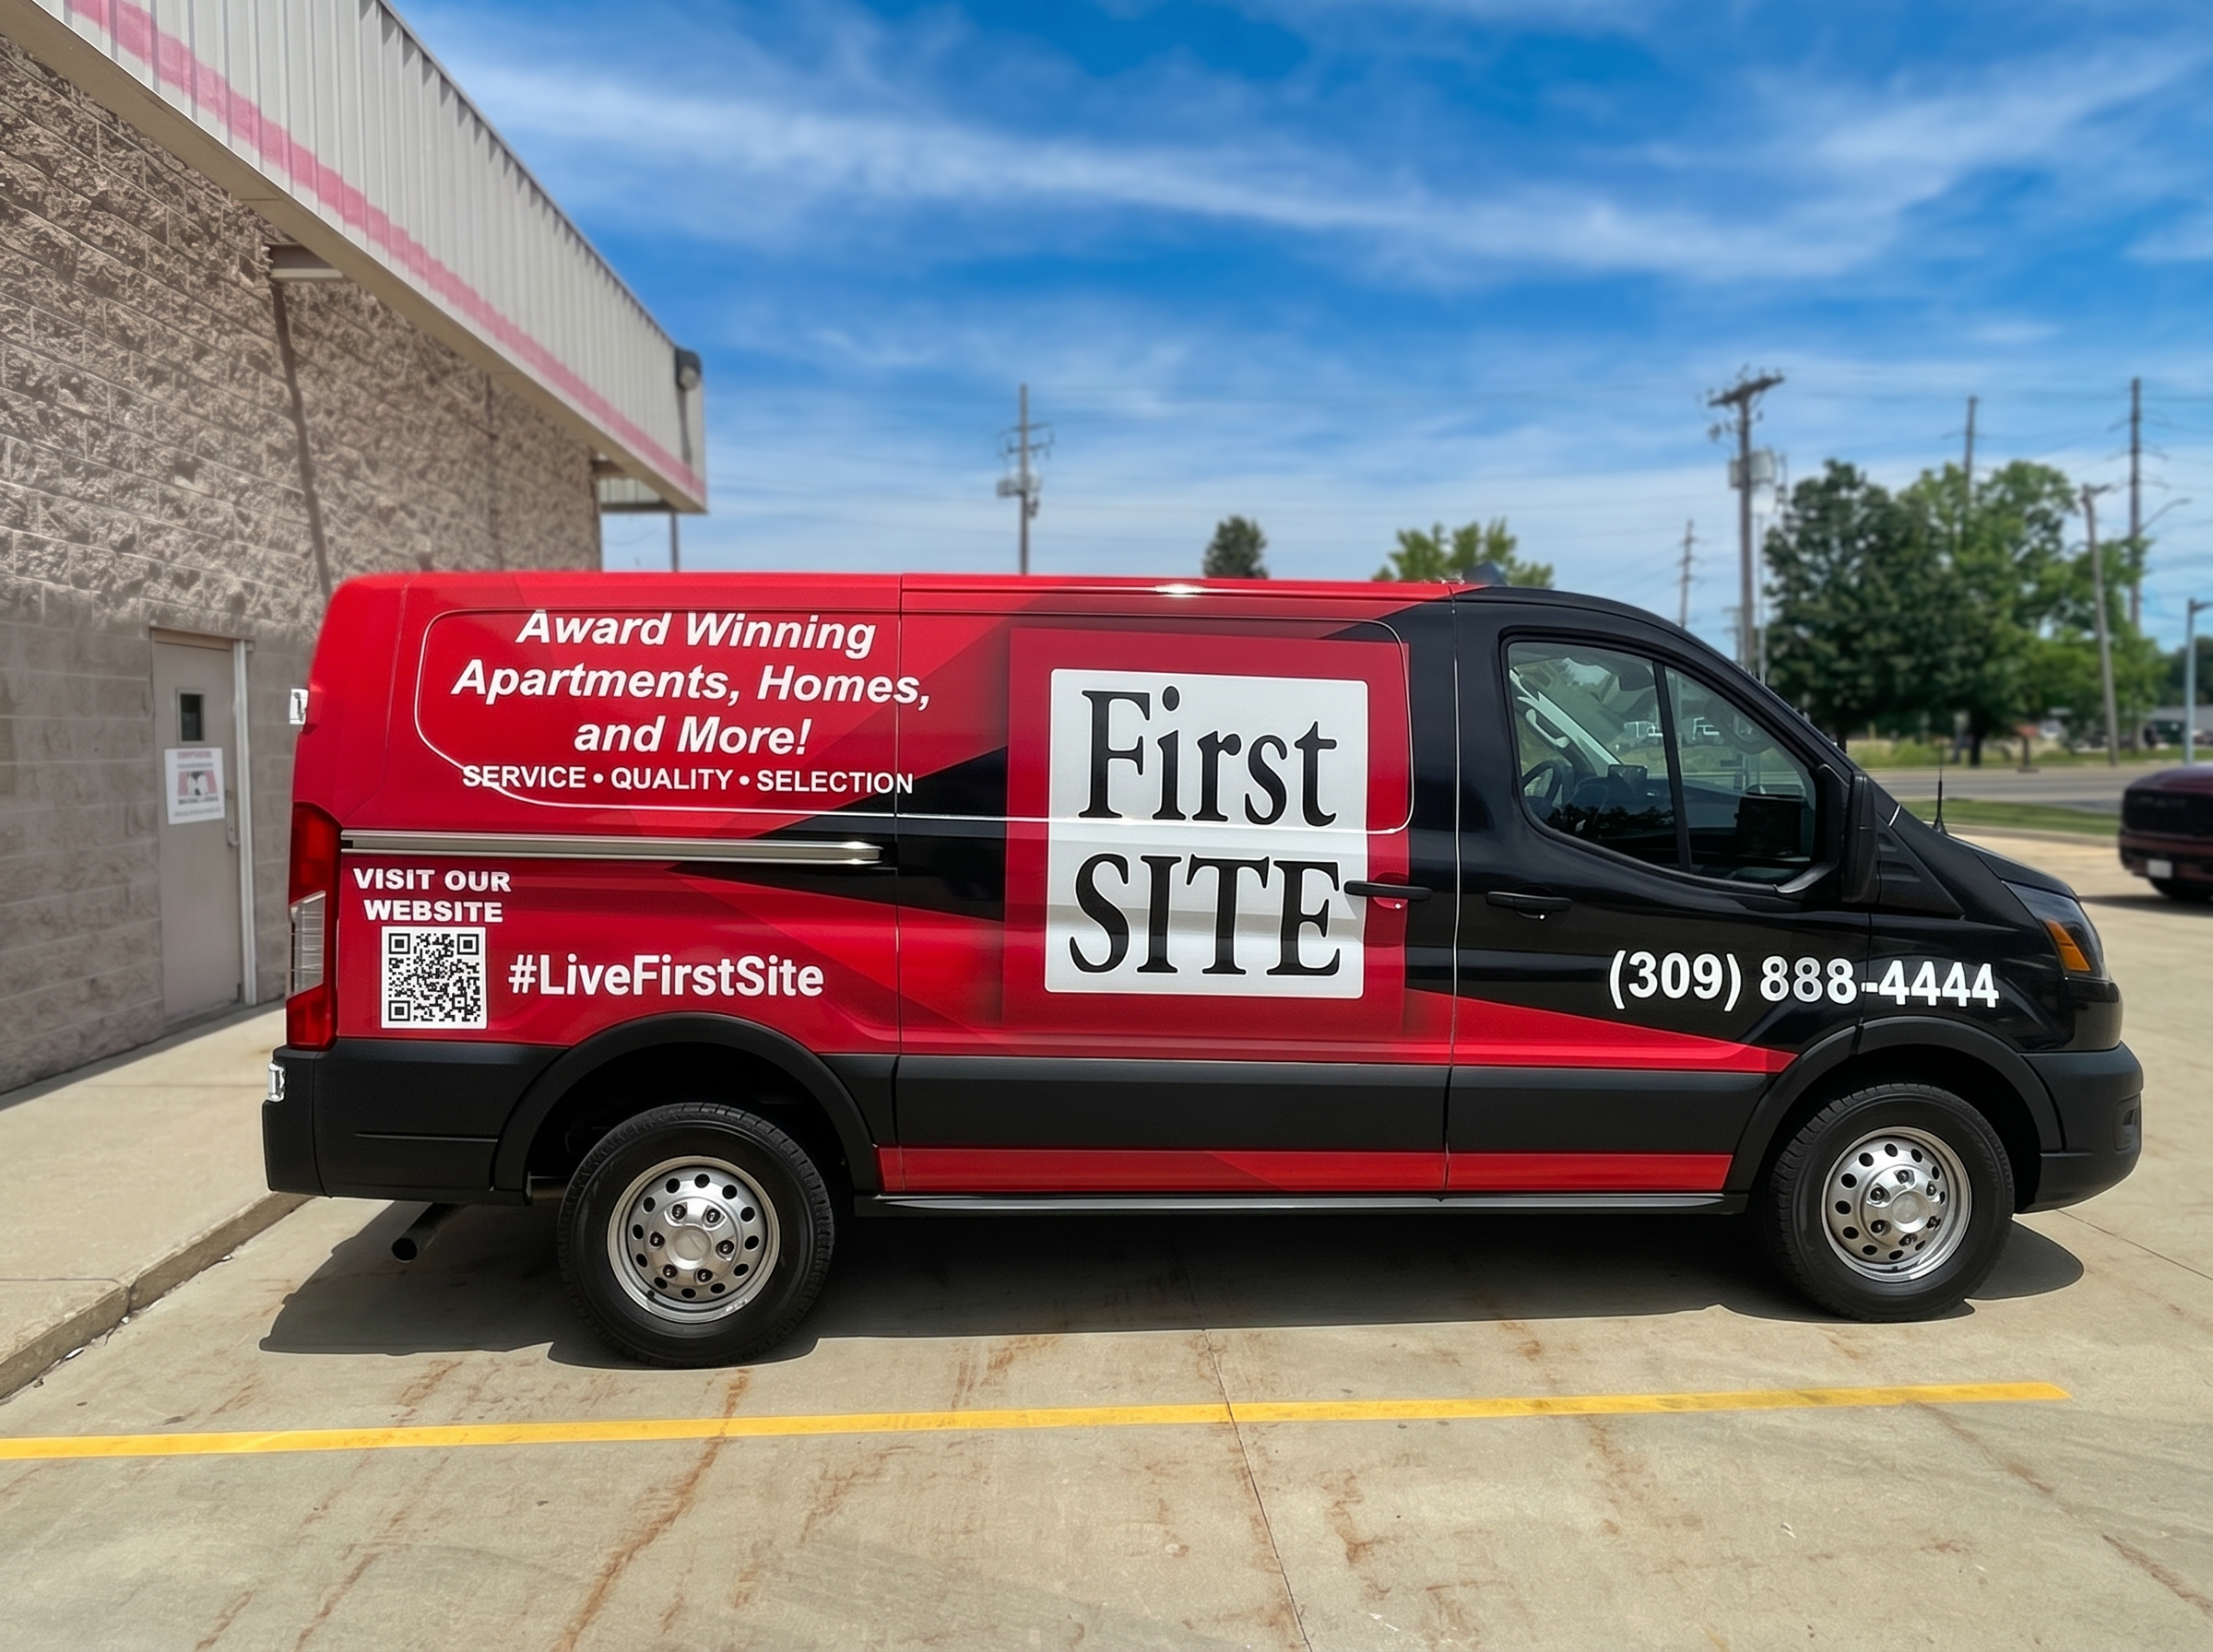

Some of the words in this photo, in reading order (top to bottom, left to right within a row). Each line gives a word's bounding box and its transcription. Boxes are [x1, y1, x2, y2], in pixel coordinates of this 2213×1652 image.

[515, 609, 672, 646] Award
[686, 611, 877, 659] Winning
[450, 658, 741, 706] Apartments,
[757, 665, 930, 711] Homes,
[574, 714, 666, 753] and
[677, 715, 812, 756] More!
[1077, 685, 1337, 827] First
[462, 764, 586, 789] SERVICE
[609, 766, 734, 791] QUALITY
[756, 769, 914, 795] SELECTION
[353, 867, 435, 891] VISIT
[444, 869, 512, 892] OUR
[363, 899, 503, 923] WEBSITE
[1069, 853, 1341, 977] SITE
[507, 952, 824, 997] #LiveFirstSite
[1608, 950, 1742, 1012] (309)
[1759, 955, 2000, 1009] 888-4444
